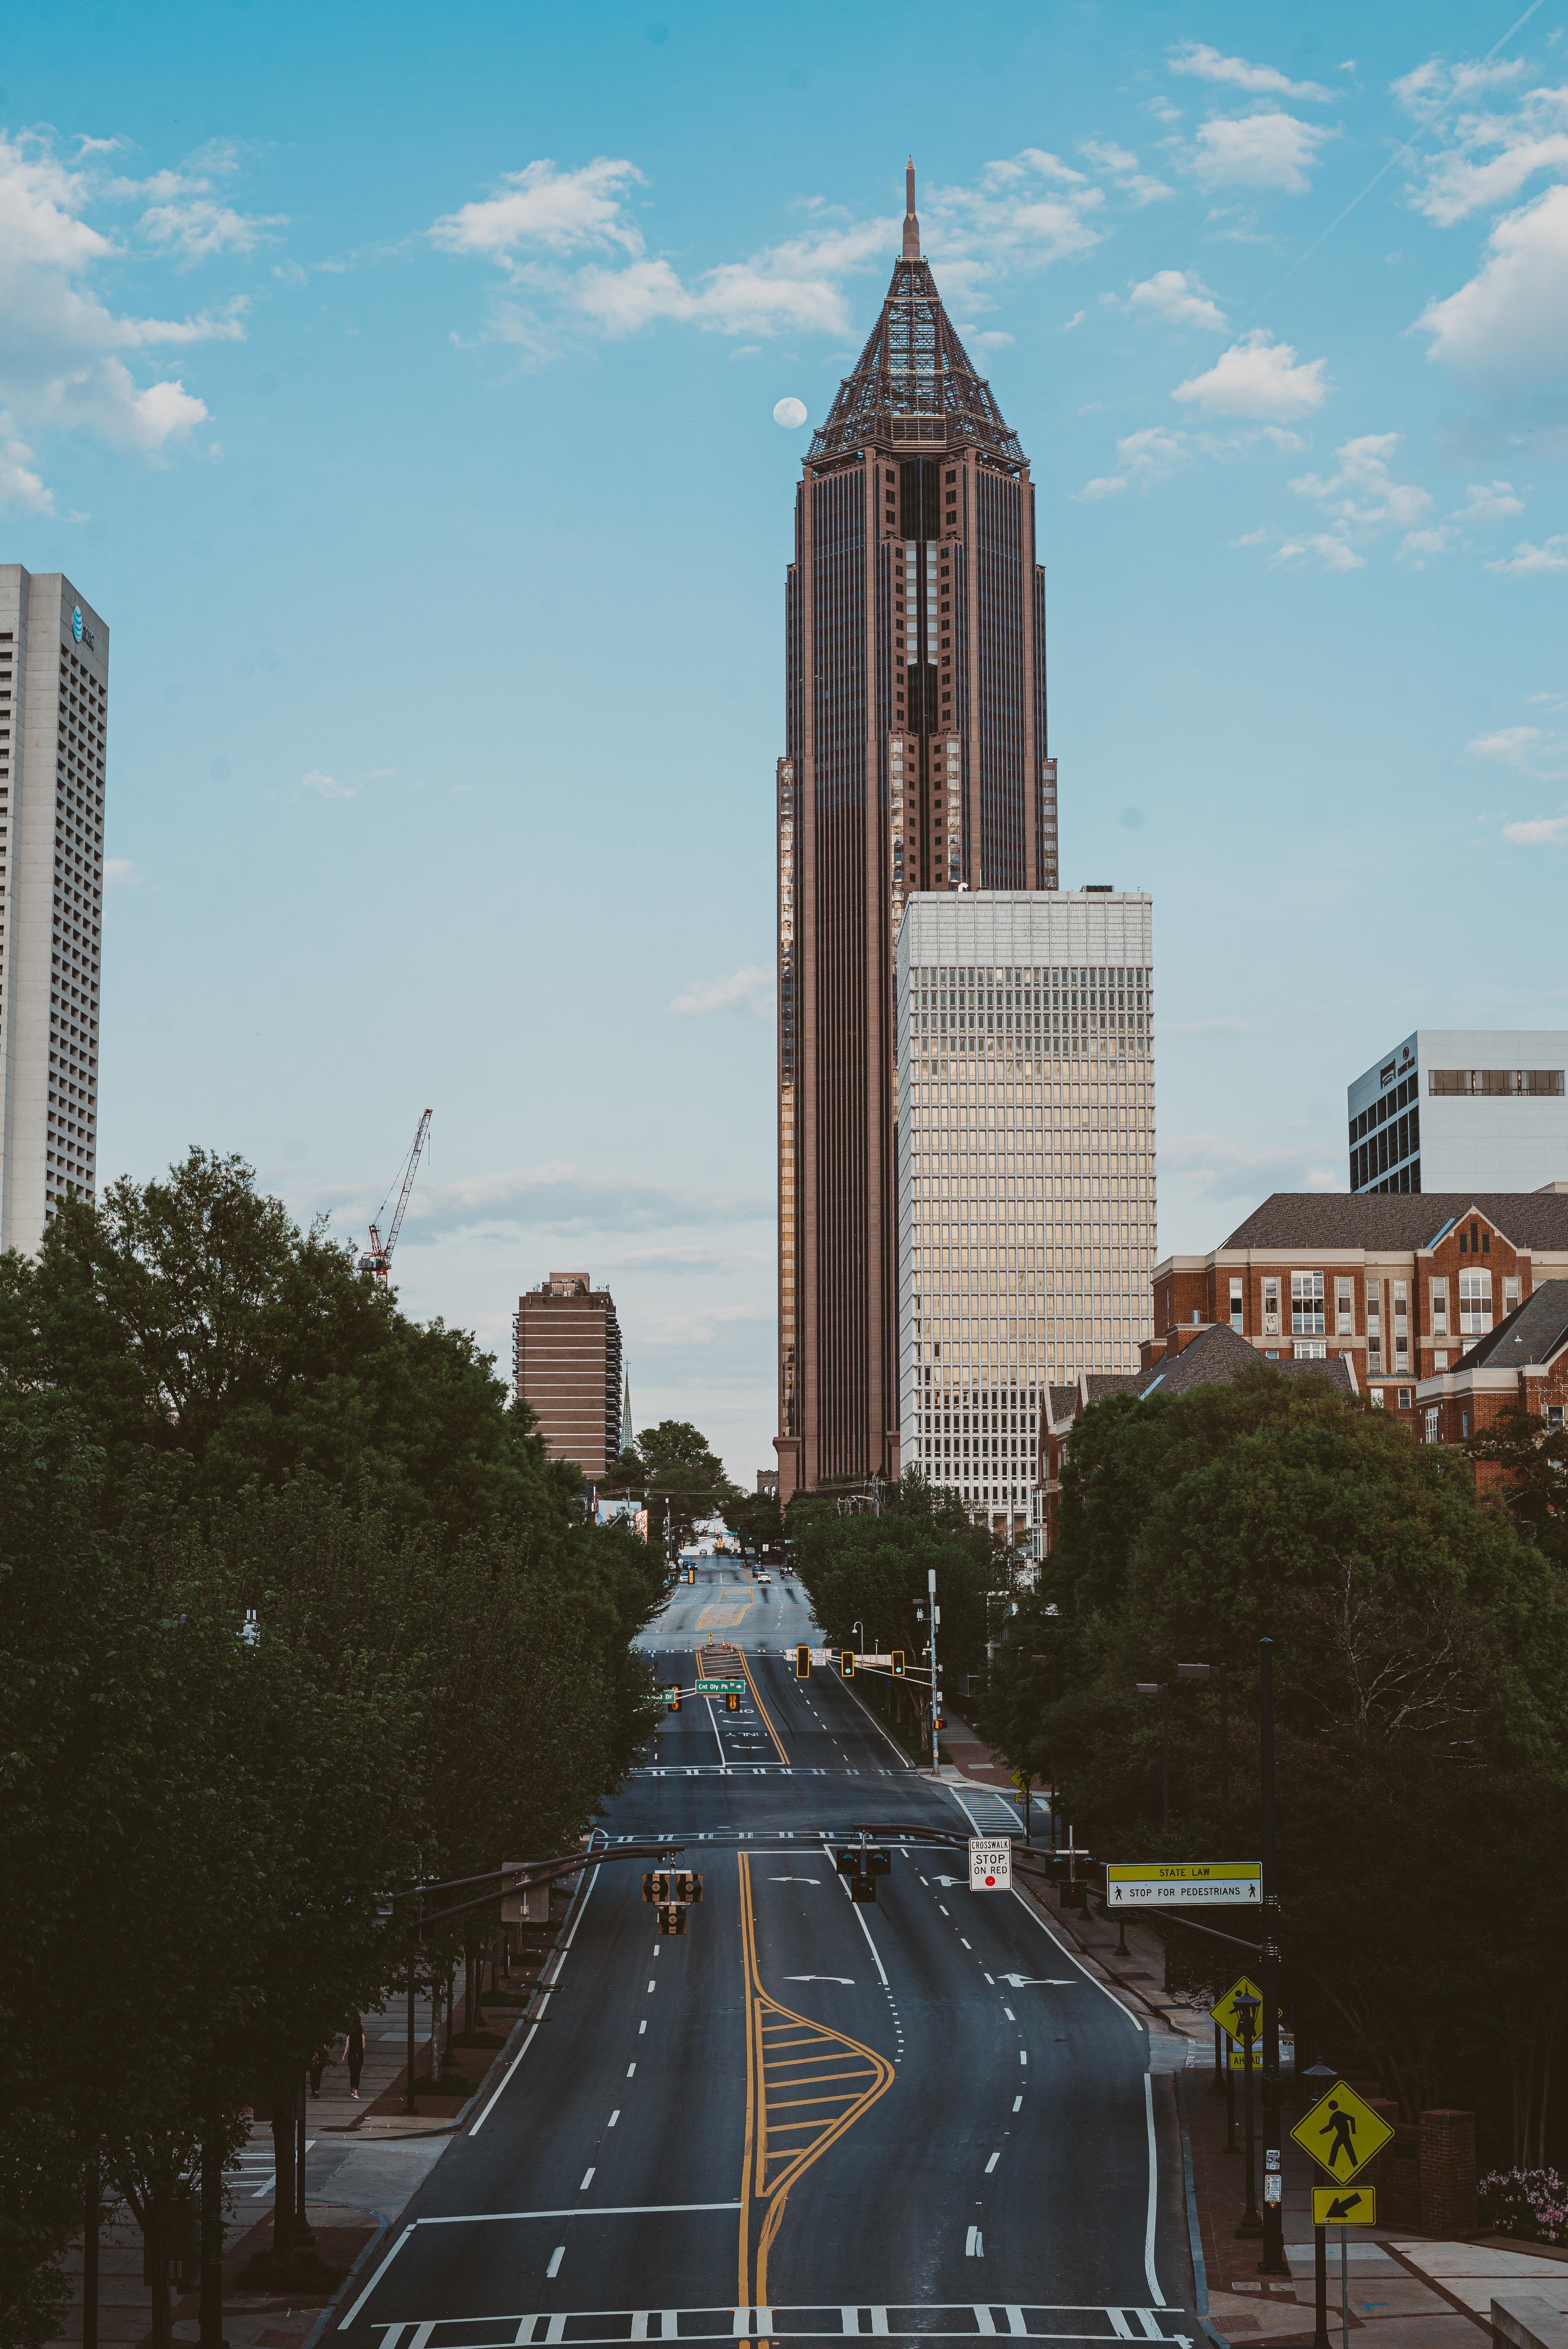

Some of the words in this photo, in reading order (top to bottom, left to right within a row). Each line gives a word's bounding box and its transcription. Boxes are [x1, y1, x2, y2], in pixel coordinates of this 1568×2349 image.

[972, 1841, 1008, 1849] CROSSWALK
[976, 1854, 1005, 1864] STOP
[1159, 1869, 1186, 1877] STATE
[1192, 1868, 1210, 1876] LAW
[1129, 1889, 1152, 1897] STOP
[1158, 1888, 1175, 1896] FOR
[1181, 1887, 1240, 1896] PEDESTRIANS
[1234, 2056, 1260, 2065] AHAD
